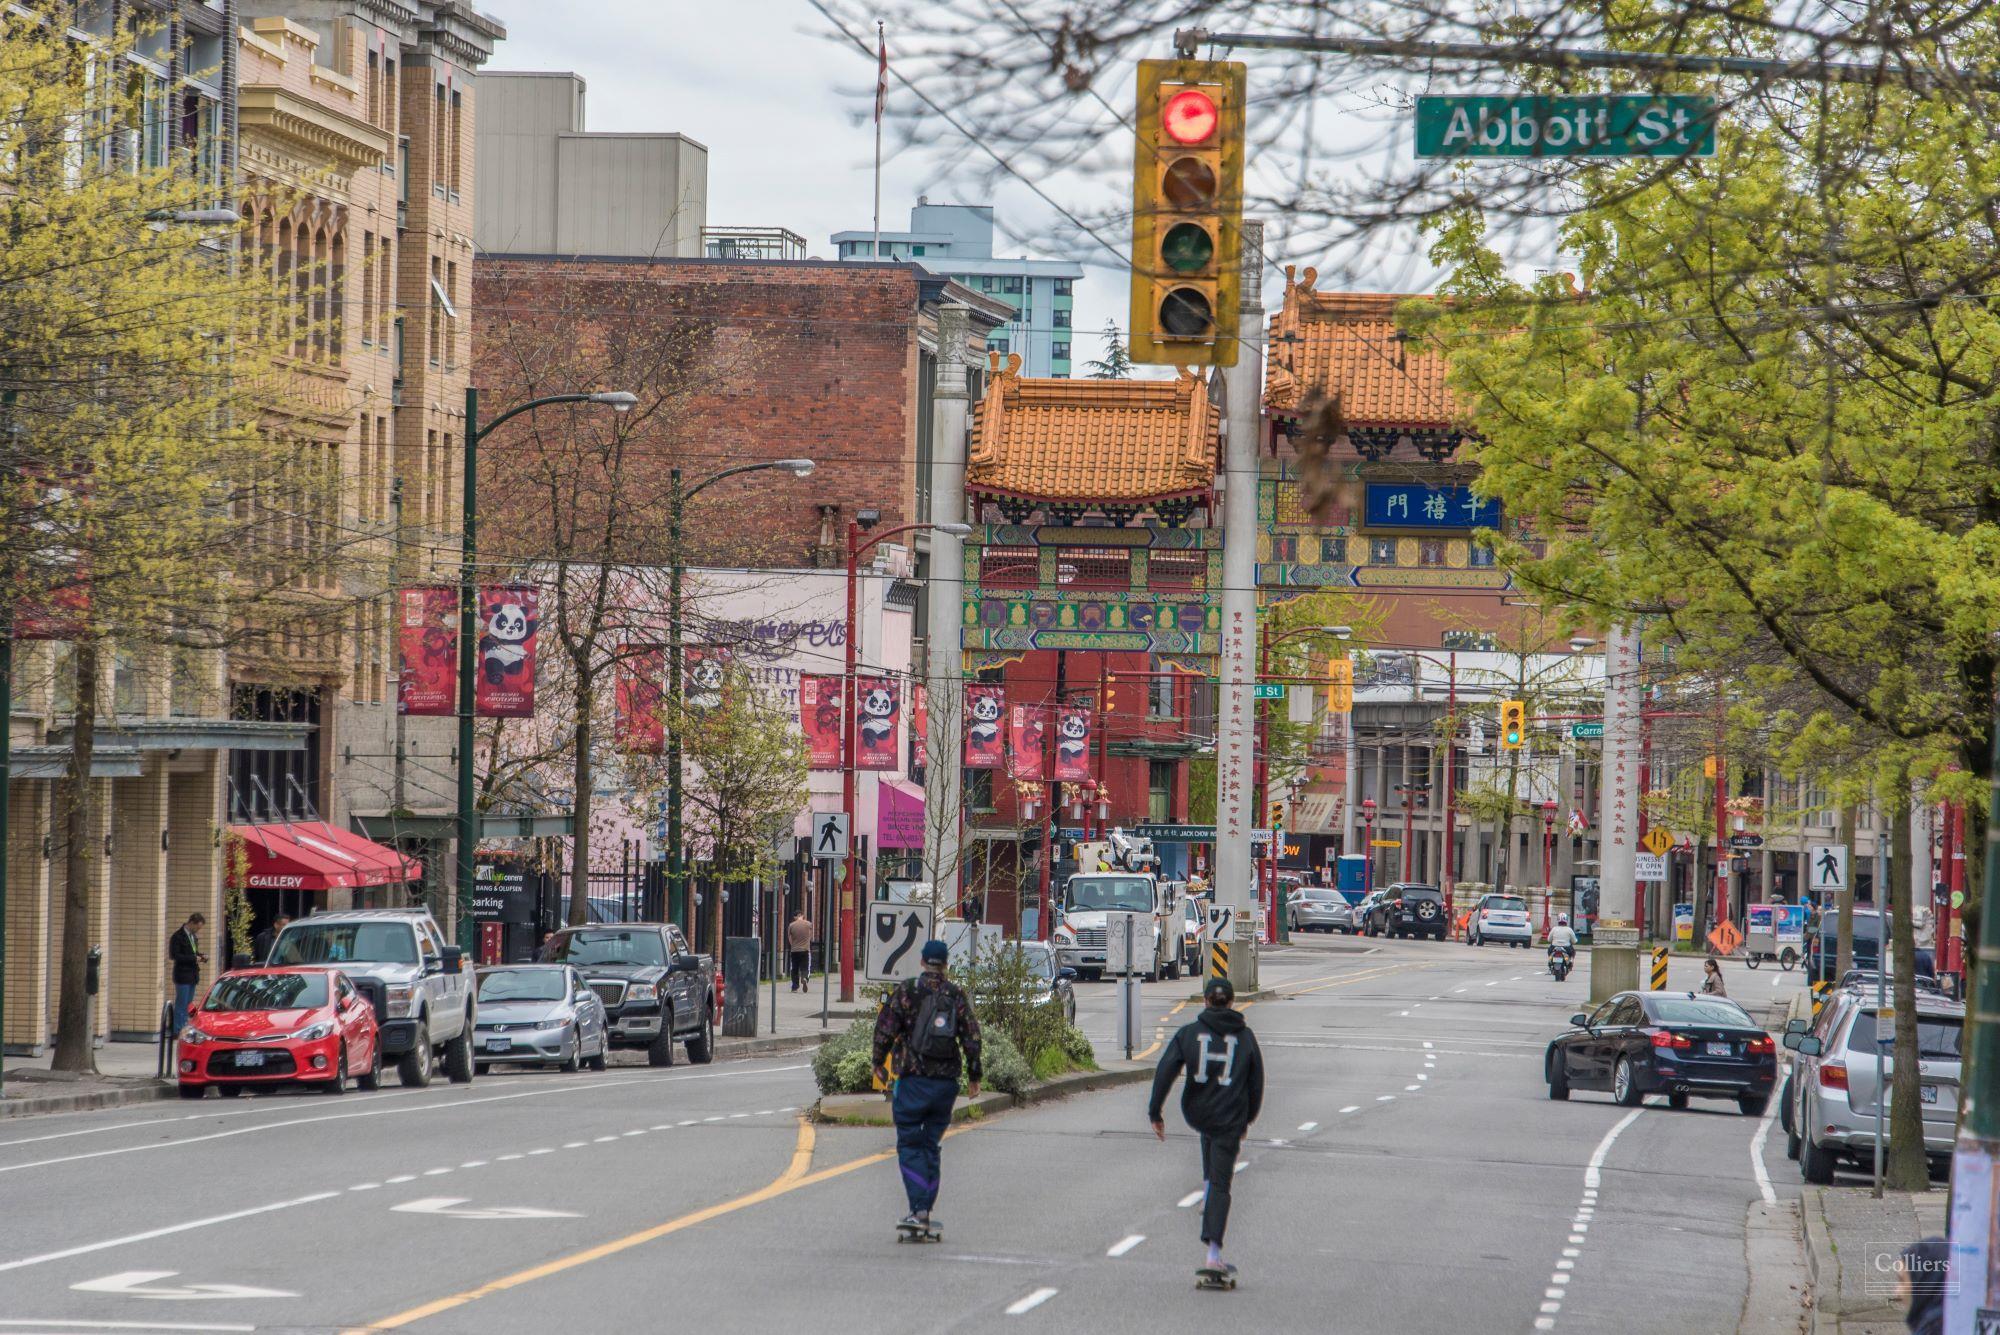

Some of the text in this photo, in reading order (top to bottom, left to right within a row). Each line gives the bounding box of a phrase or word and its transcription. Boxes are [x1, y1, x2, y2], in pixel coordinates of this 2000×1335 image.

[1442, 106, 1690, 146] Abbott St
[1266, 686, 1278, 696] St
[1576, 726, 1601, 735] Carra
[250, 875, 303, 888] GALLERY
[1194, 1033, 1238, 1086] H
